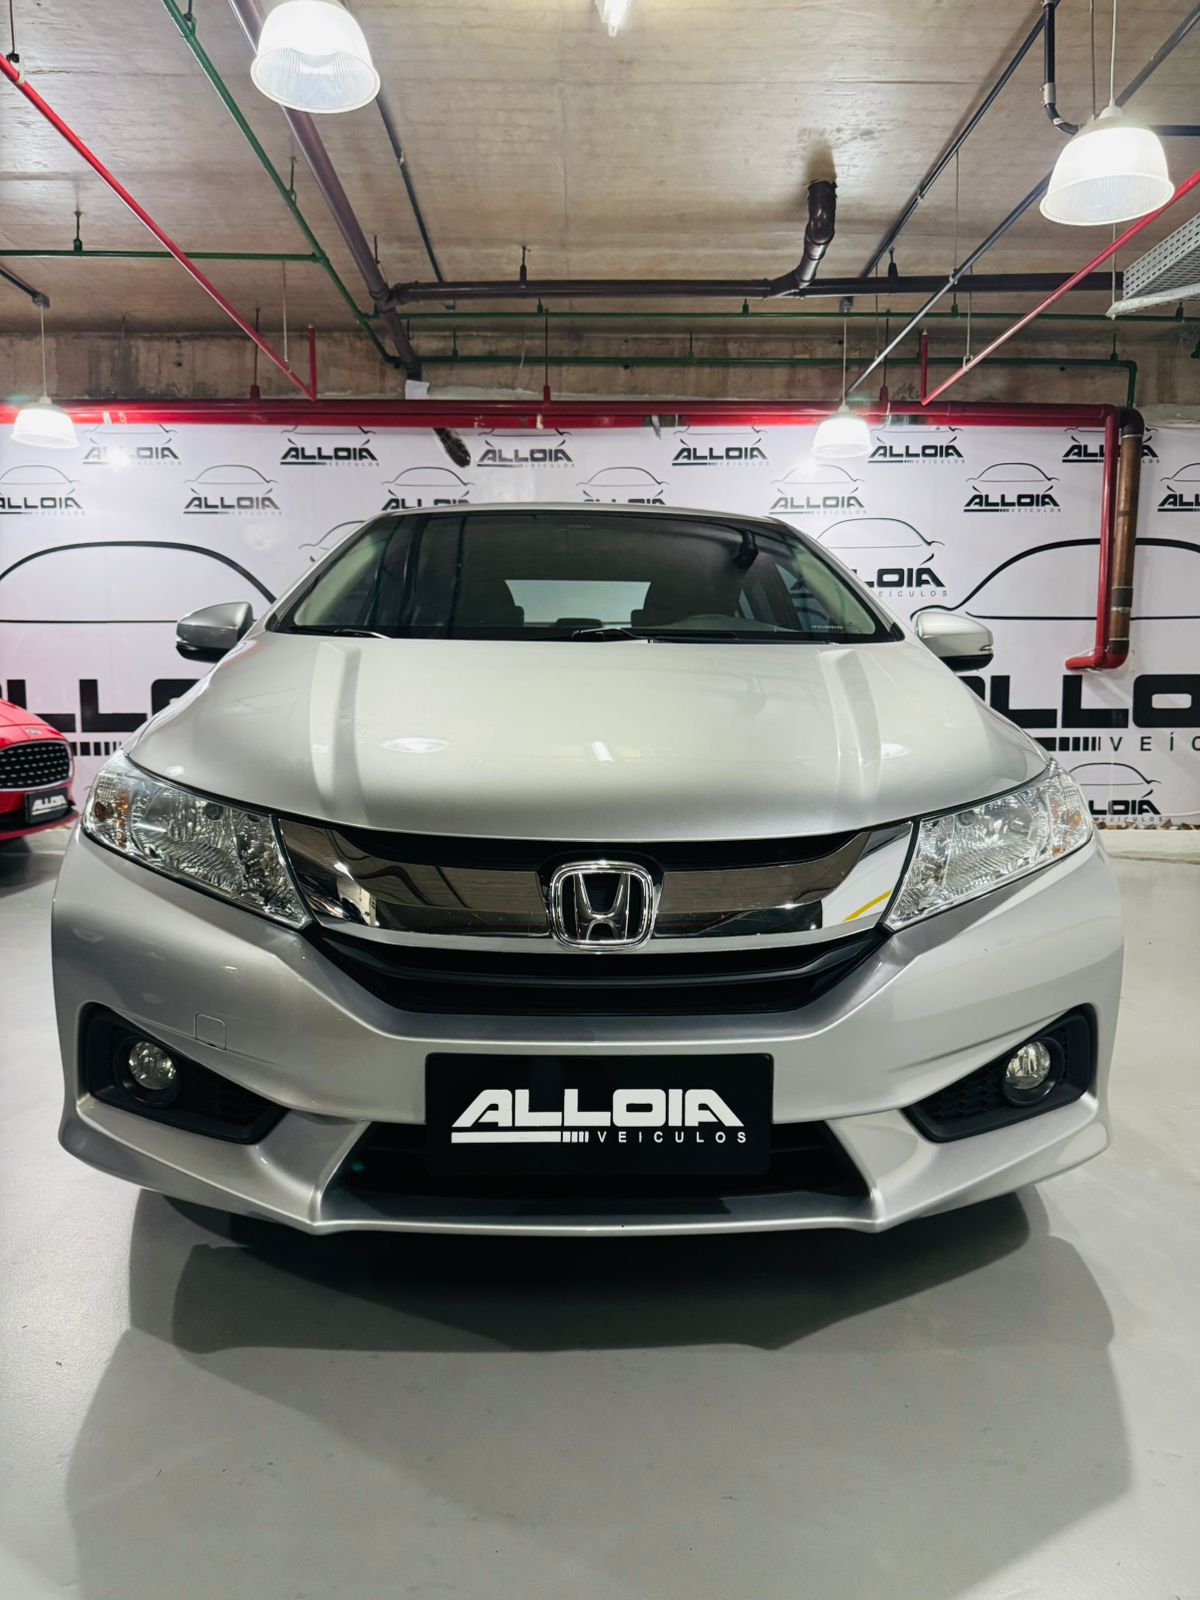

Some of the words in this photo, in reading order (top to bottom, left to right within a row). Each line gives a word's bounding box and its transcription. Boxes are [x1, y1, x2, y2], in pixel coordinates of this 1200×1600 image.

[281, 446, 378, 461] ALLOIA
[478, 448, 573, 462] ALLOIA
[672, 446, 768, 460] ALLOIA
[868, 444, 964, 458] ALLOIA
[183, 496, 281, 509] ALLOIA
[769, 495, 865, 509] ALLOIA
[964, 493, 1060, 507] ALLOIA
[451, 1088, 746, 1128] ALLOIA
[597, 1130, 747, 1144] VEICULOS
